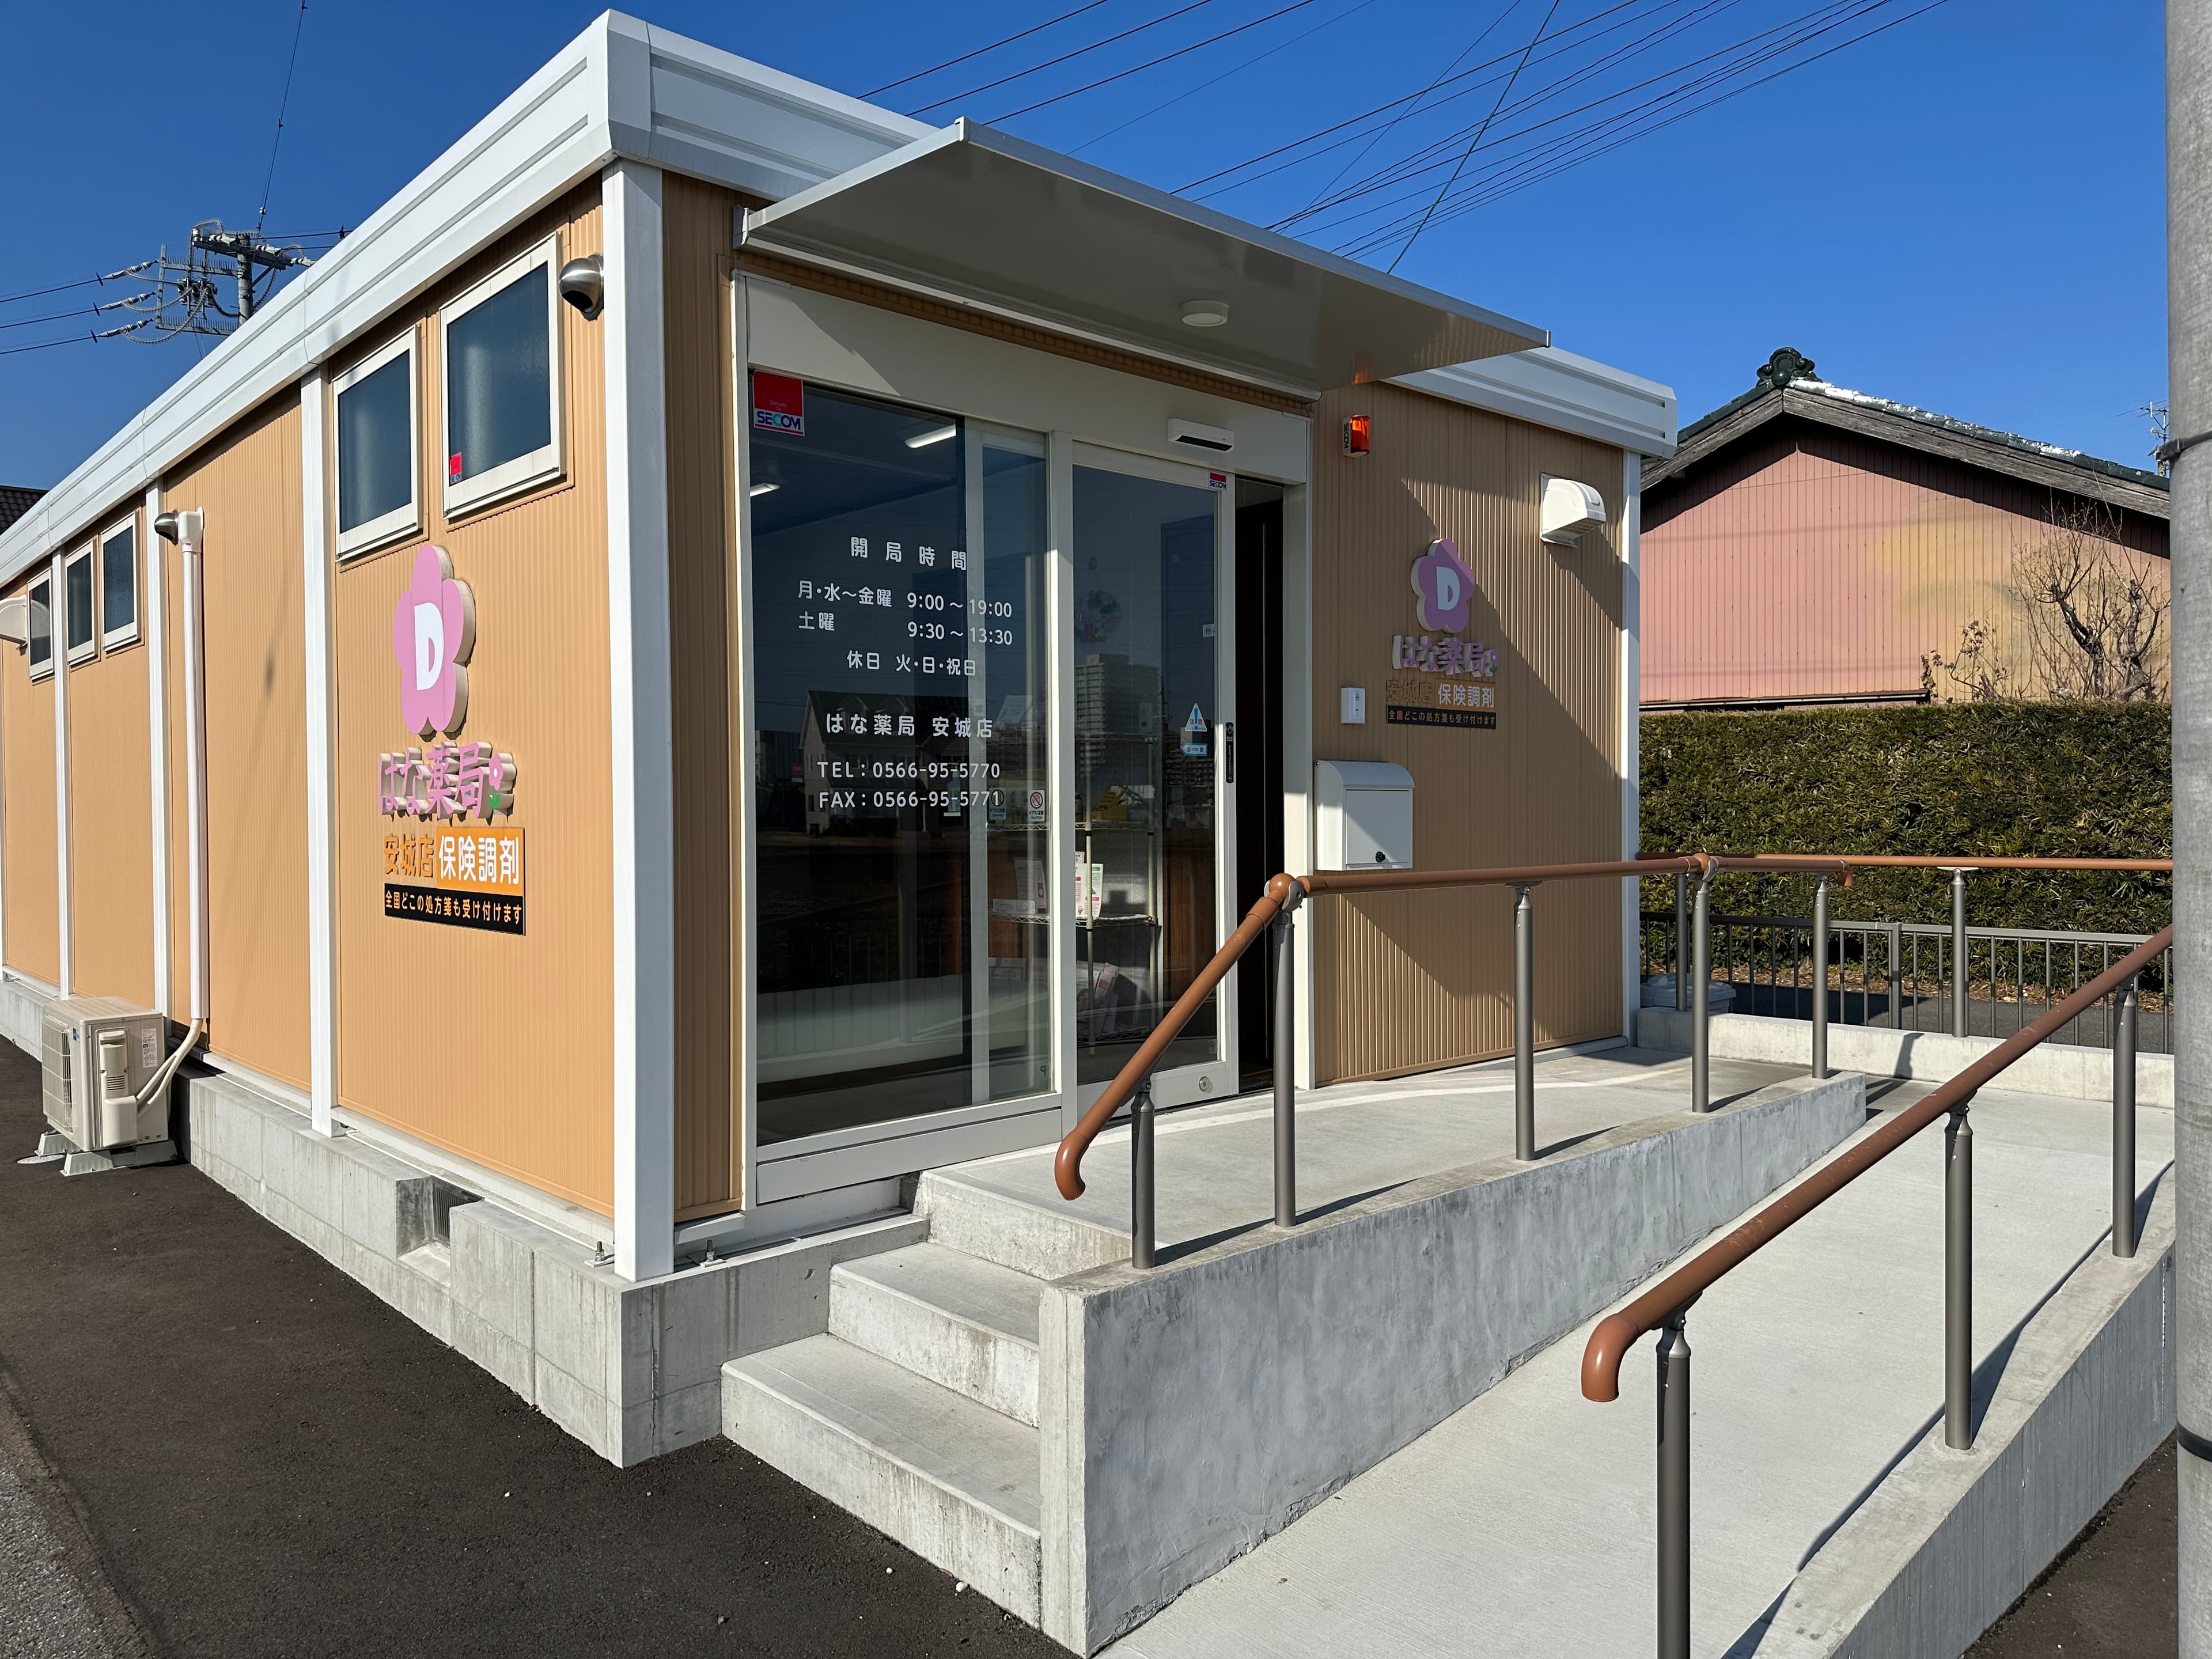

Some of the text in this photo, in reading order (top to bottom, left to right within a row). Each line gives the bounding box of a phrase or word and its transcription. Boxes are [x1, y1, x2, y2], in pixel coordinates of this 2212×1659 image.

[757, 411, 801, 430] SECOM
[1210, 480, 1226, 490] SECOM
[851, 536, 967, 571] 開局時間
[1436, 566, 1460, 610] D
[798, 611, 835, 631] 土曜
[414, 602, 444, 691] D
[847, 650, 880, 670] 休日
[1393, 633, 1484, 677] はな薬局
[1438, 683, 1494, 708] 保険調剤
[827, 713, 993, 738] はな薬局 安城店
[378, 741, 485, 819] はな薬局
[383, 834, 520, 885] 安城店 保険調剤
[385, 890, 522, 925] 全国どこの処方箋も受け付けます
